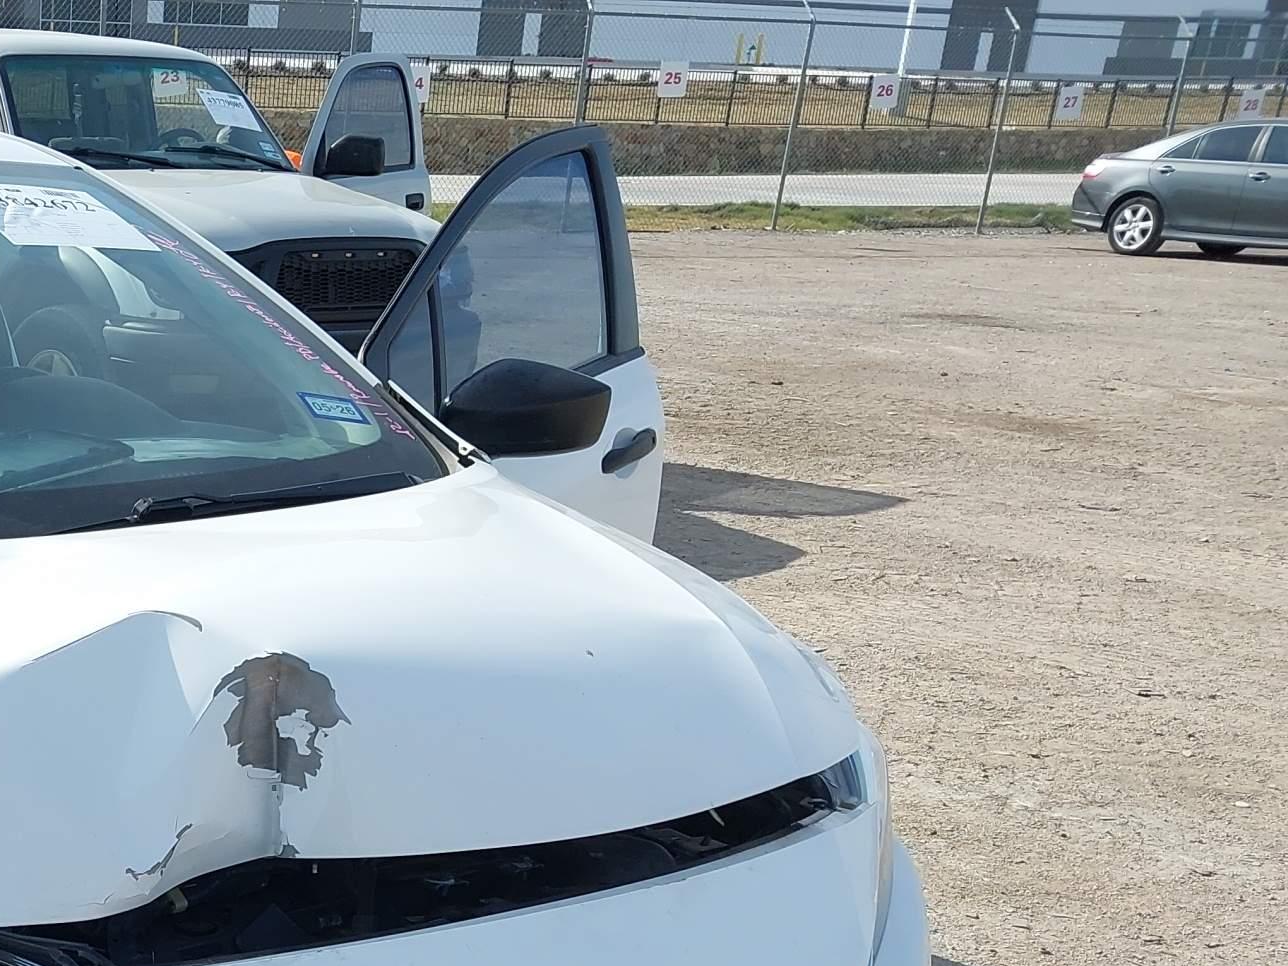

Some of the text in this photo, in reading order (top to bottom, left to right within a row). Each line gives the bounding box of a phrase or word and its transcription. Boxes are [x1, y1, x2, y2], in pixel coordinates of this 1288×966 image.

[160, 71, 180, 84] 23
[414, 77, 424, 90] 4
[664, 72, 682, 85] 25
[877, 84, 894, 97] 26
[1063, 96, 1079, 108] 27
[1243, 99, 1259, 112] 28
